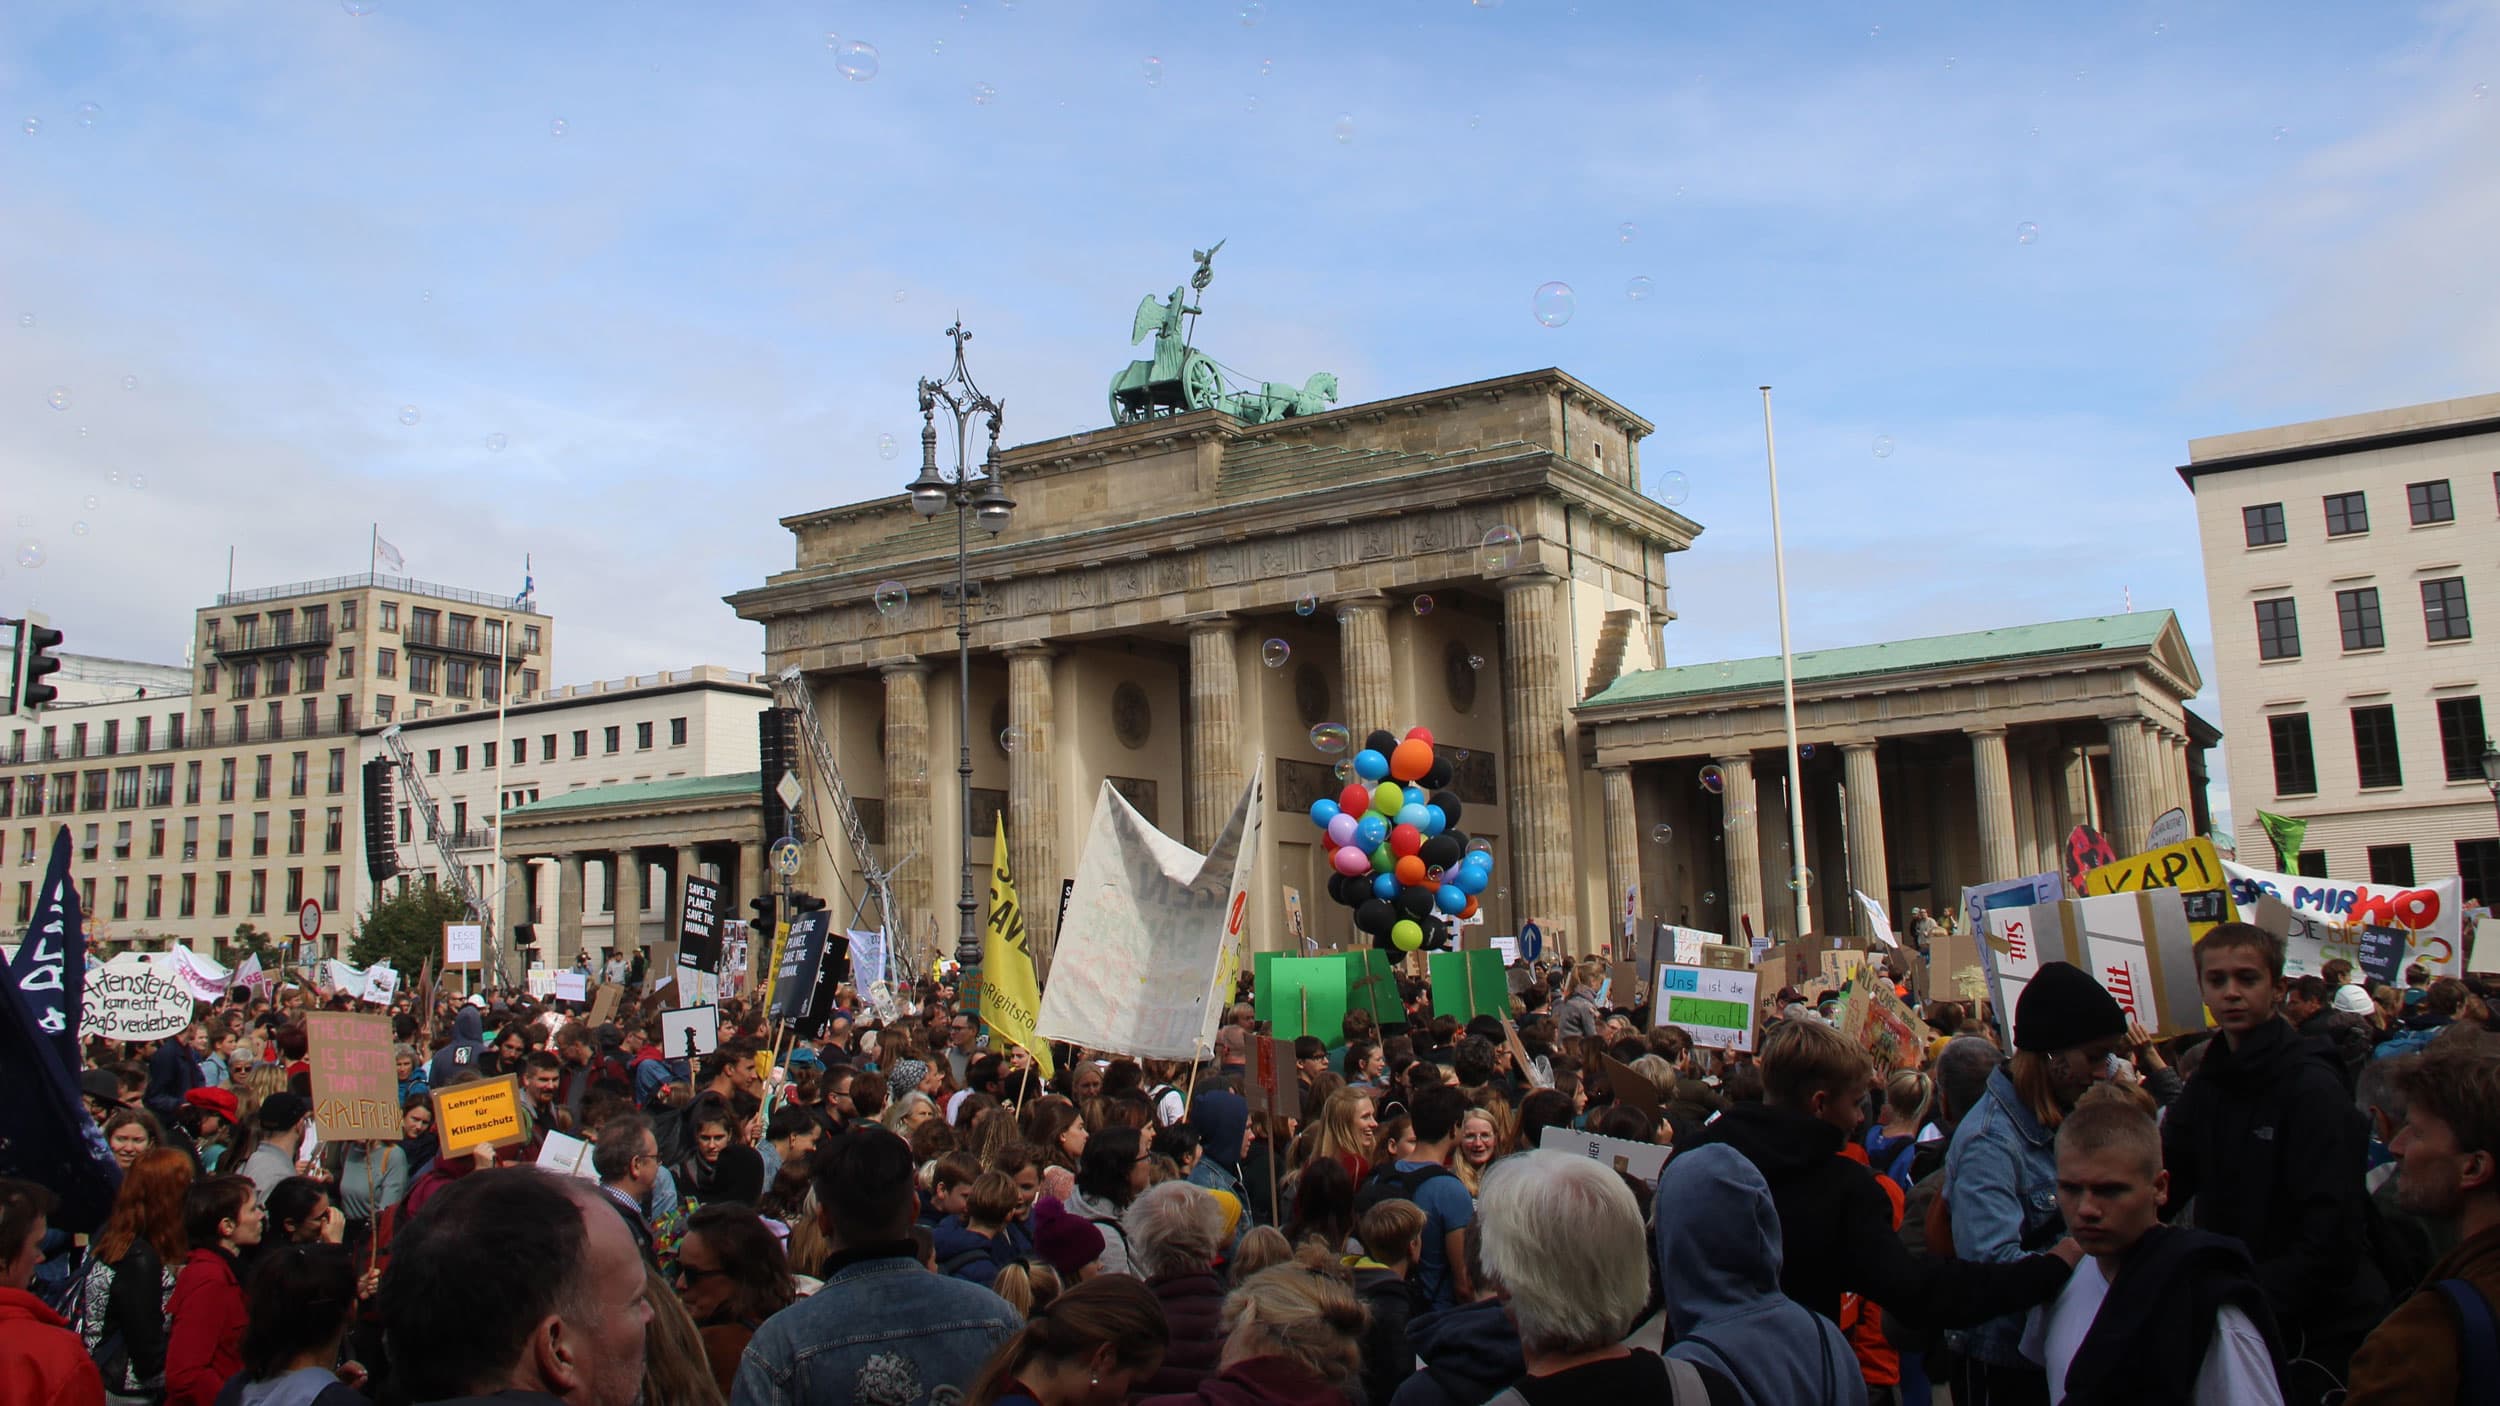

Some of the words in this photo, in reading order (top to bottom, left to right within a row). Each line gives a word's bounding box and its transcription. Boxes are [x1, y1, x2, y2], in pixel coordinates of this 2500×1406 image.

[688, 882, 704, 897] SAVE
[706, 886, 717, 900] THE
[2228, 878, 2281, 906] SAG
[2292, 885, 2358, 914] MIR
[2347, 885, 2441, 930] WO
[686, 908, 702, 922] SAVE
[703, 912, 715, 926] THE
[2287, 916, 2321, 940] DIE
[2004, 919, 2027, 965] Silit
[83, 966, 191, 1012] Artensterben
[1664, 968, 1694, 990] Uns
[1708, 980, 1722, 993] ist
[1730, 982, 1744, 994] die
[103, 995, 130, 1010] kann
[131, 995, 159, 1011] echt
[1670, 997, 1746, 1029] Zukunft
[81, 1002, 118, 1035] Spaß
[121, 1010, 187, 1033] verderben
[474, 1108, 487, 1117] für
[451, 1115, 514, 1136] Klimaschutz
